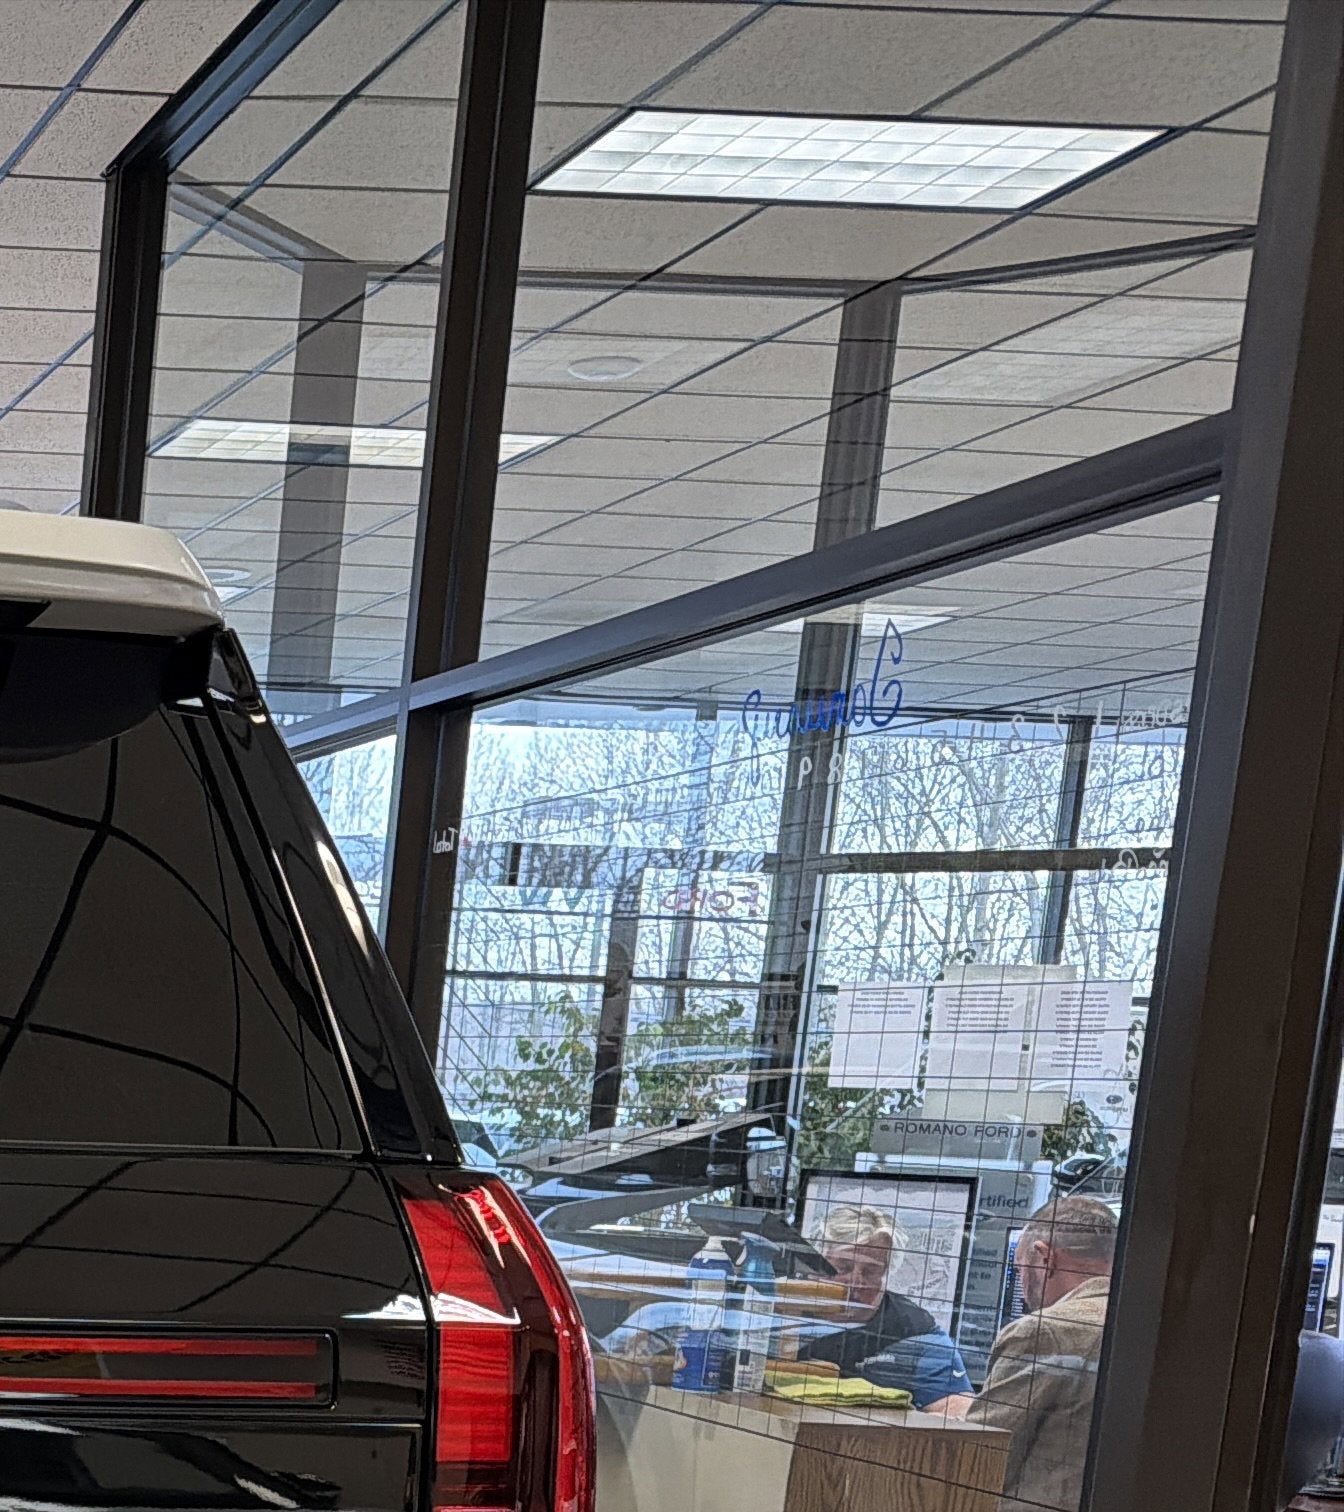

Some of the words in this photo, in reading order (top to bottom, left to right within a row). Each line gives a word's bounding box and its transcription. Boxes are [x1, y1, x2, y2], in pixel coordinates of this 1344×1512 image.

[894, 1121, 968, 1137] ROMANO
[974, 1123, 1023, 1139] FORD
[978, 1194, 1031, 1209] rtified
